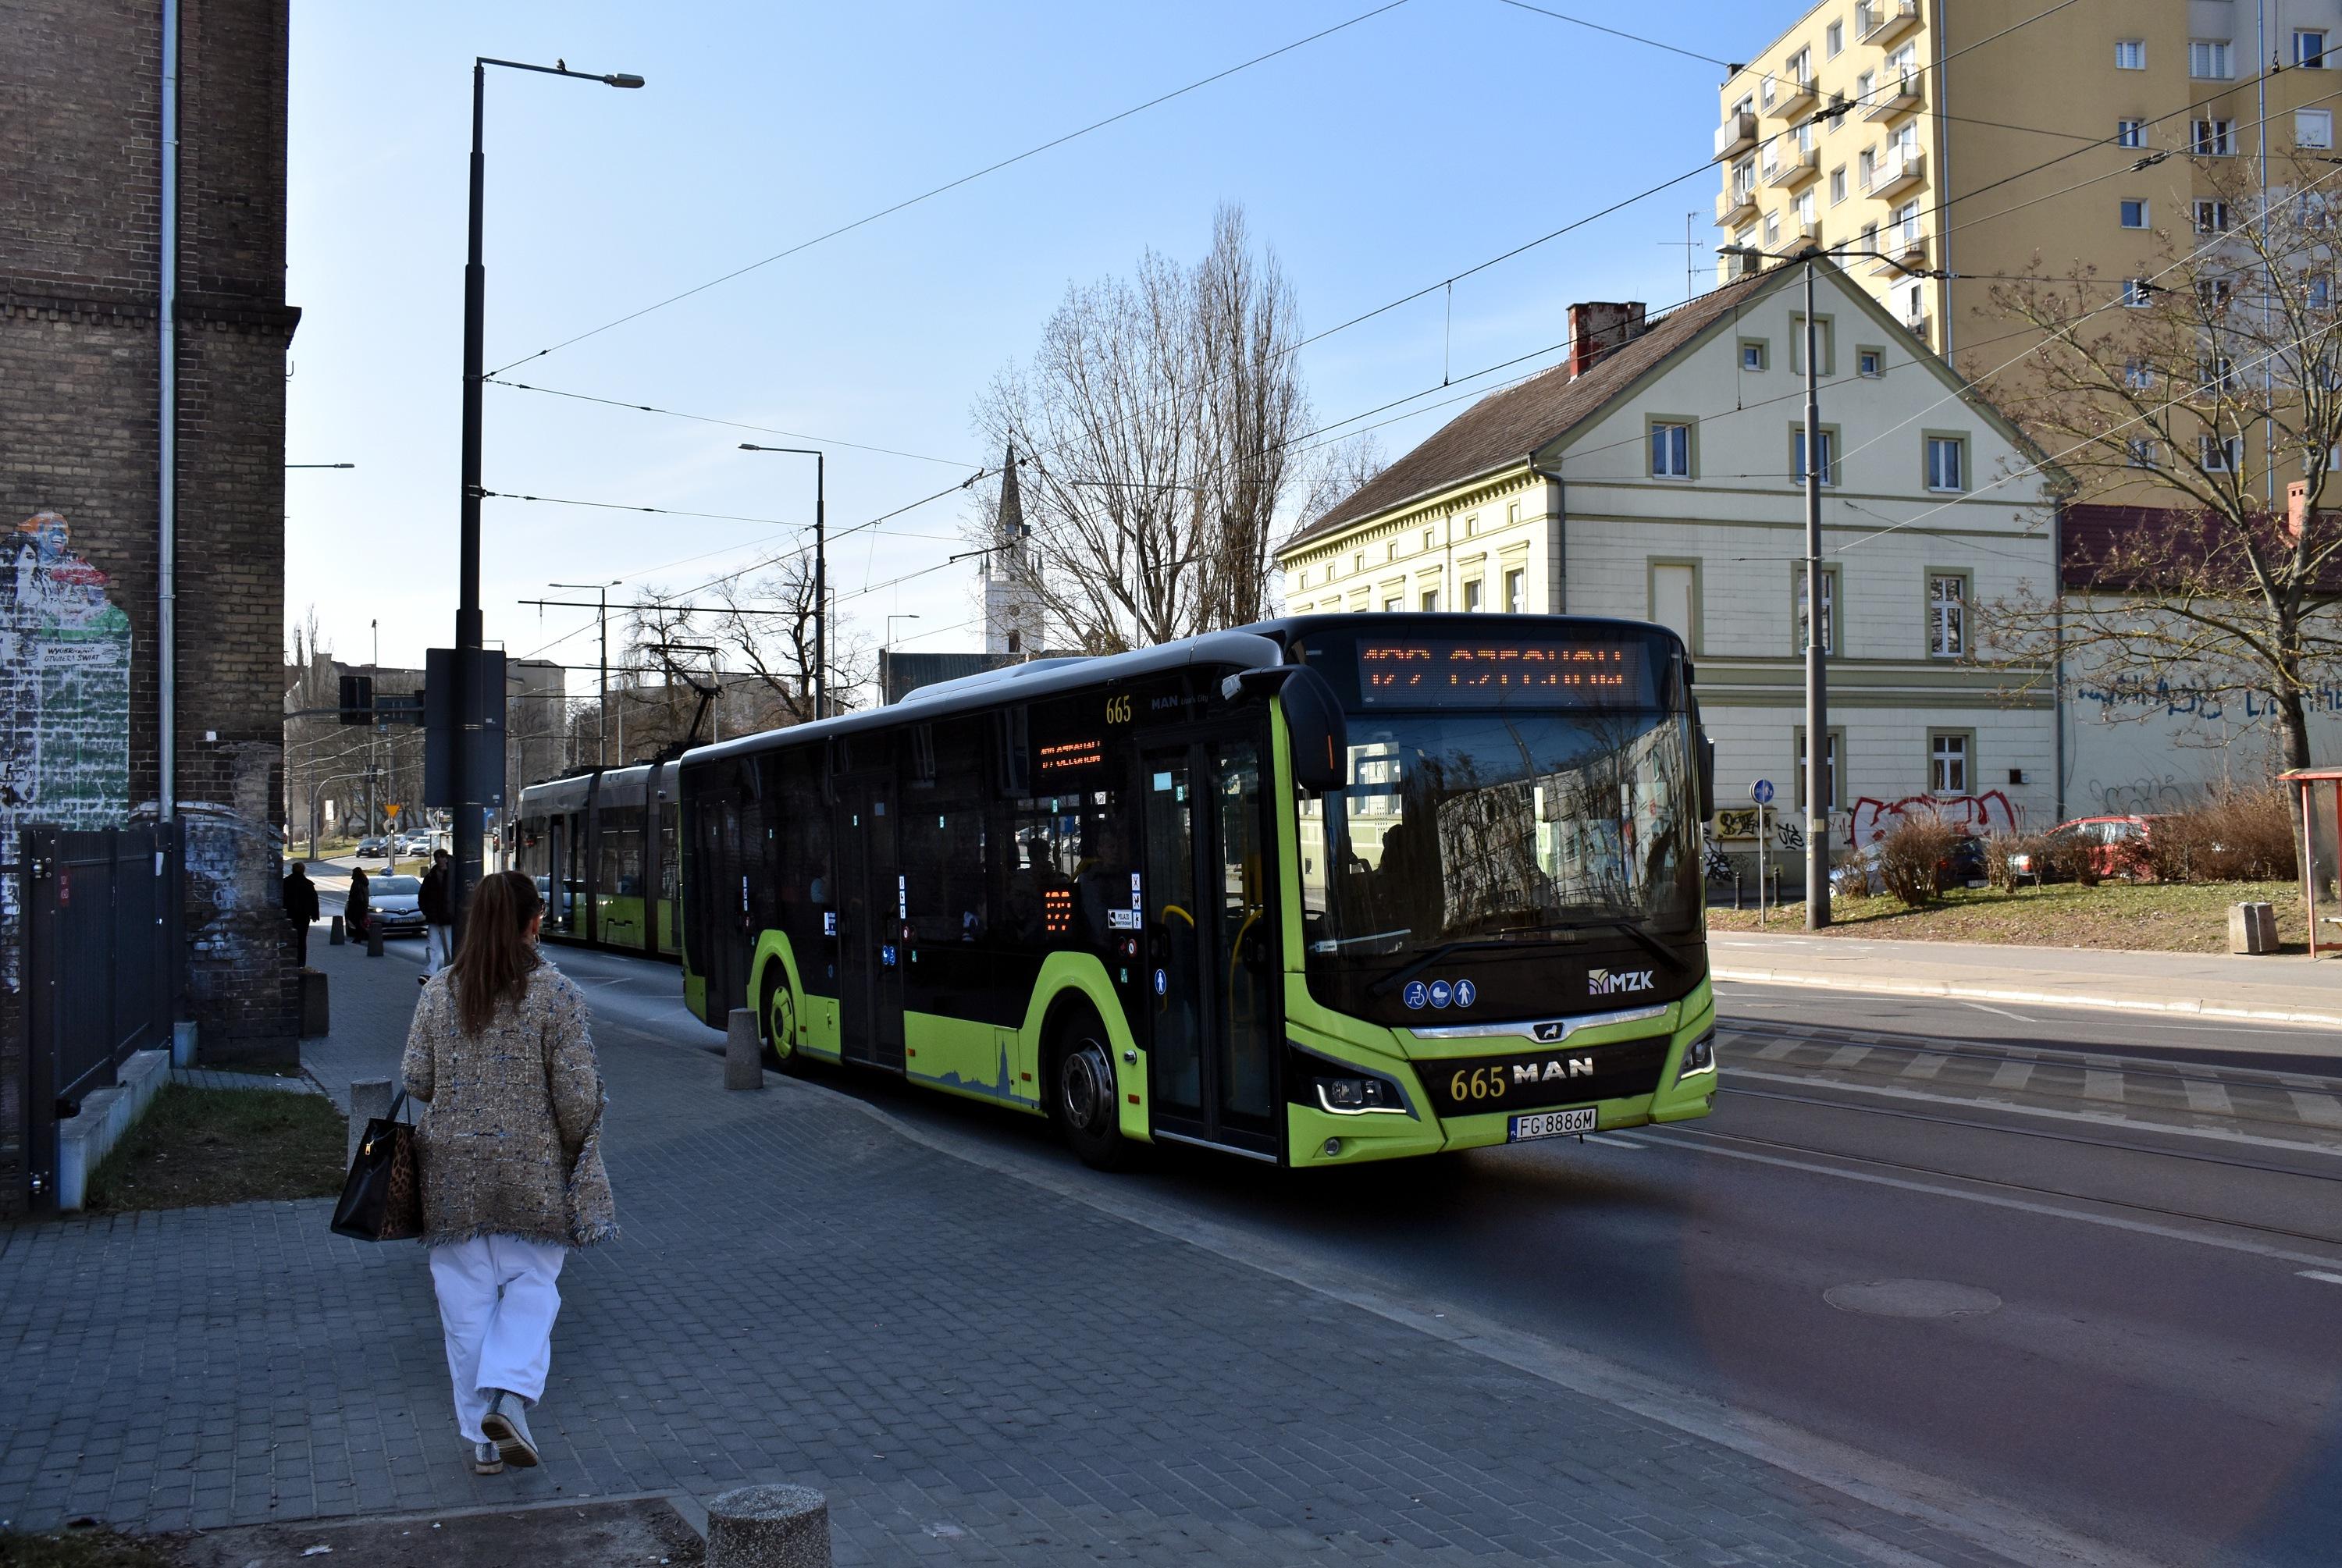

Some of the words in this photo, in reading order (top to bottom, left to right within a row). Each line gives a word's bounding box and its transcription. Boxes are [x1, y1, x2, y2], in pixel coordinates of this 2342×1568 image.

[1106, 695, 1131, 724] 665
[1151, 695, 1178, 710] MAN
[1609, 970, 1654, 993] MZK
[1450, 1065, 1506, 1101] 665
[1512, 1057, 1593, 1085] MAN
[1520, 1118, 1540, 1136] FG
[1546, 1111, 1593, 1132] 8886M
